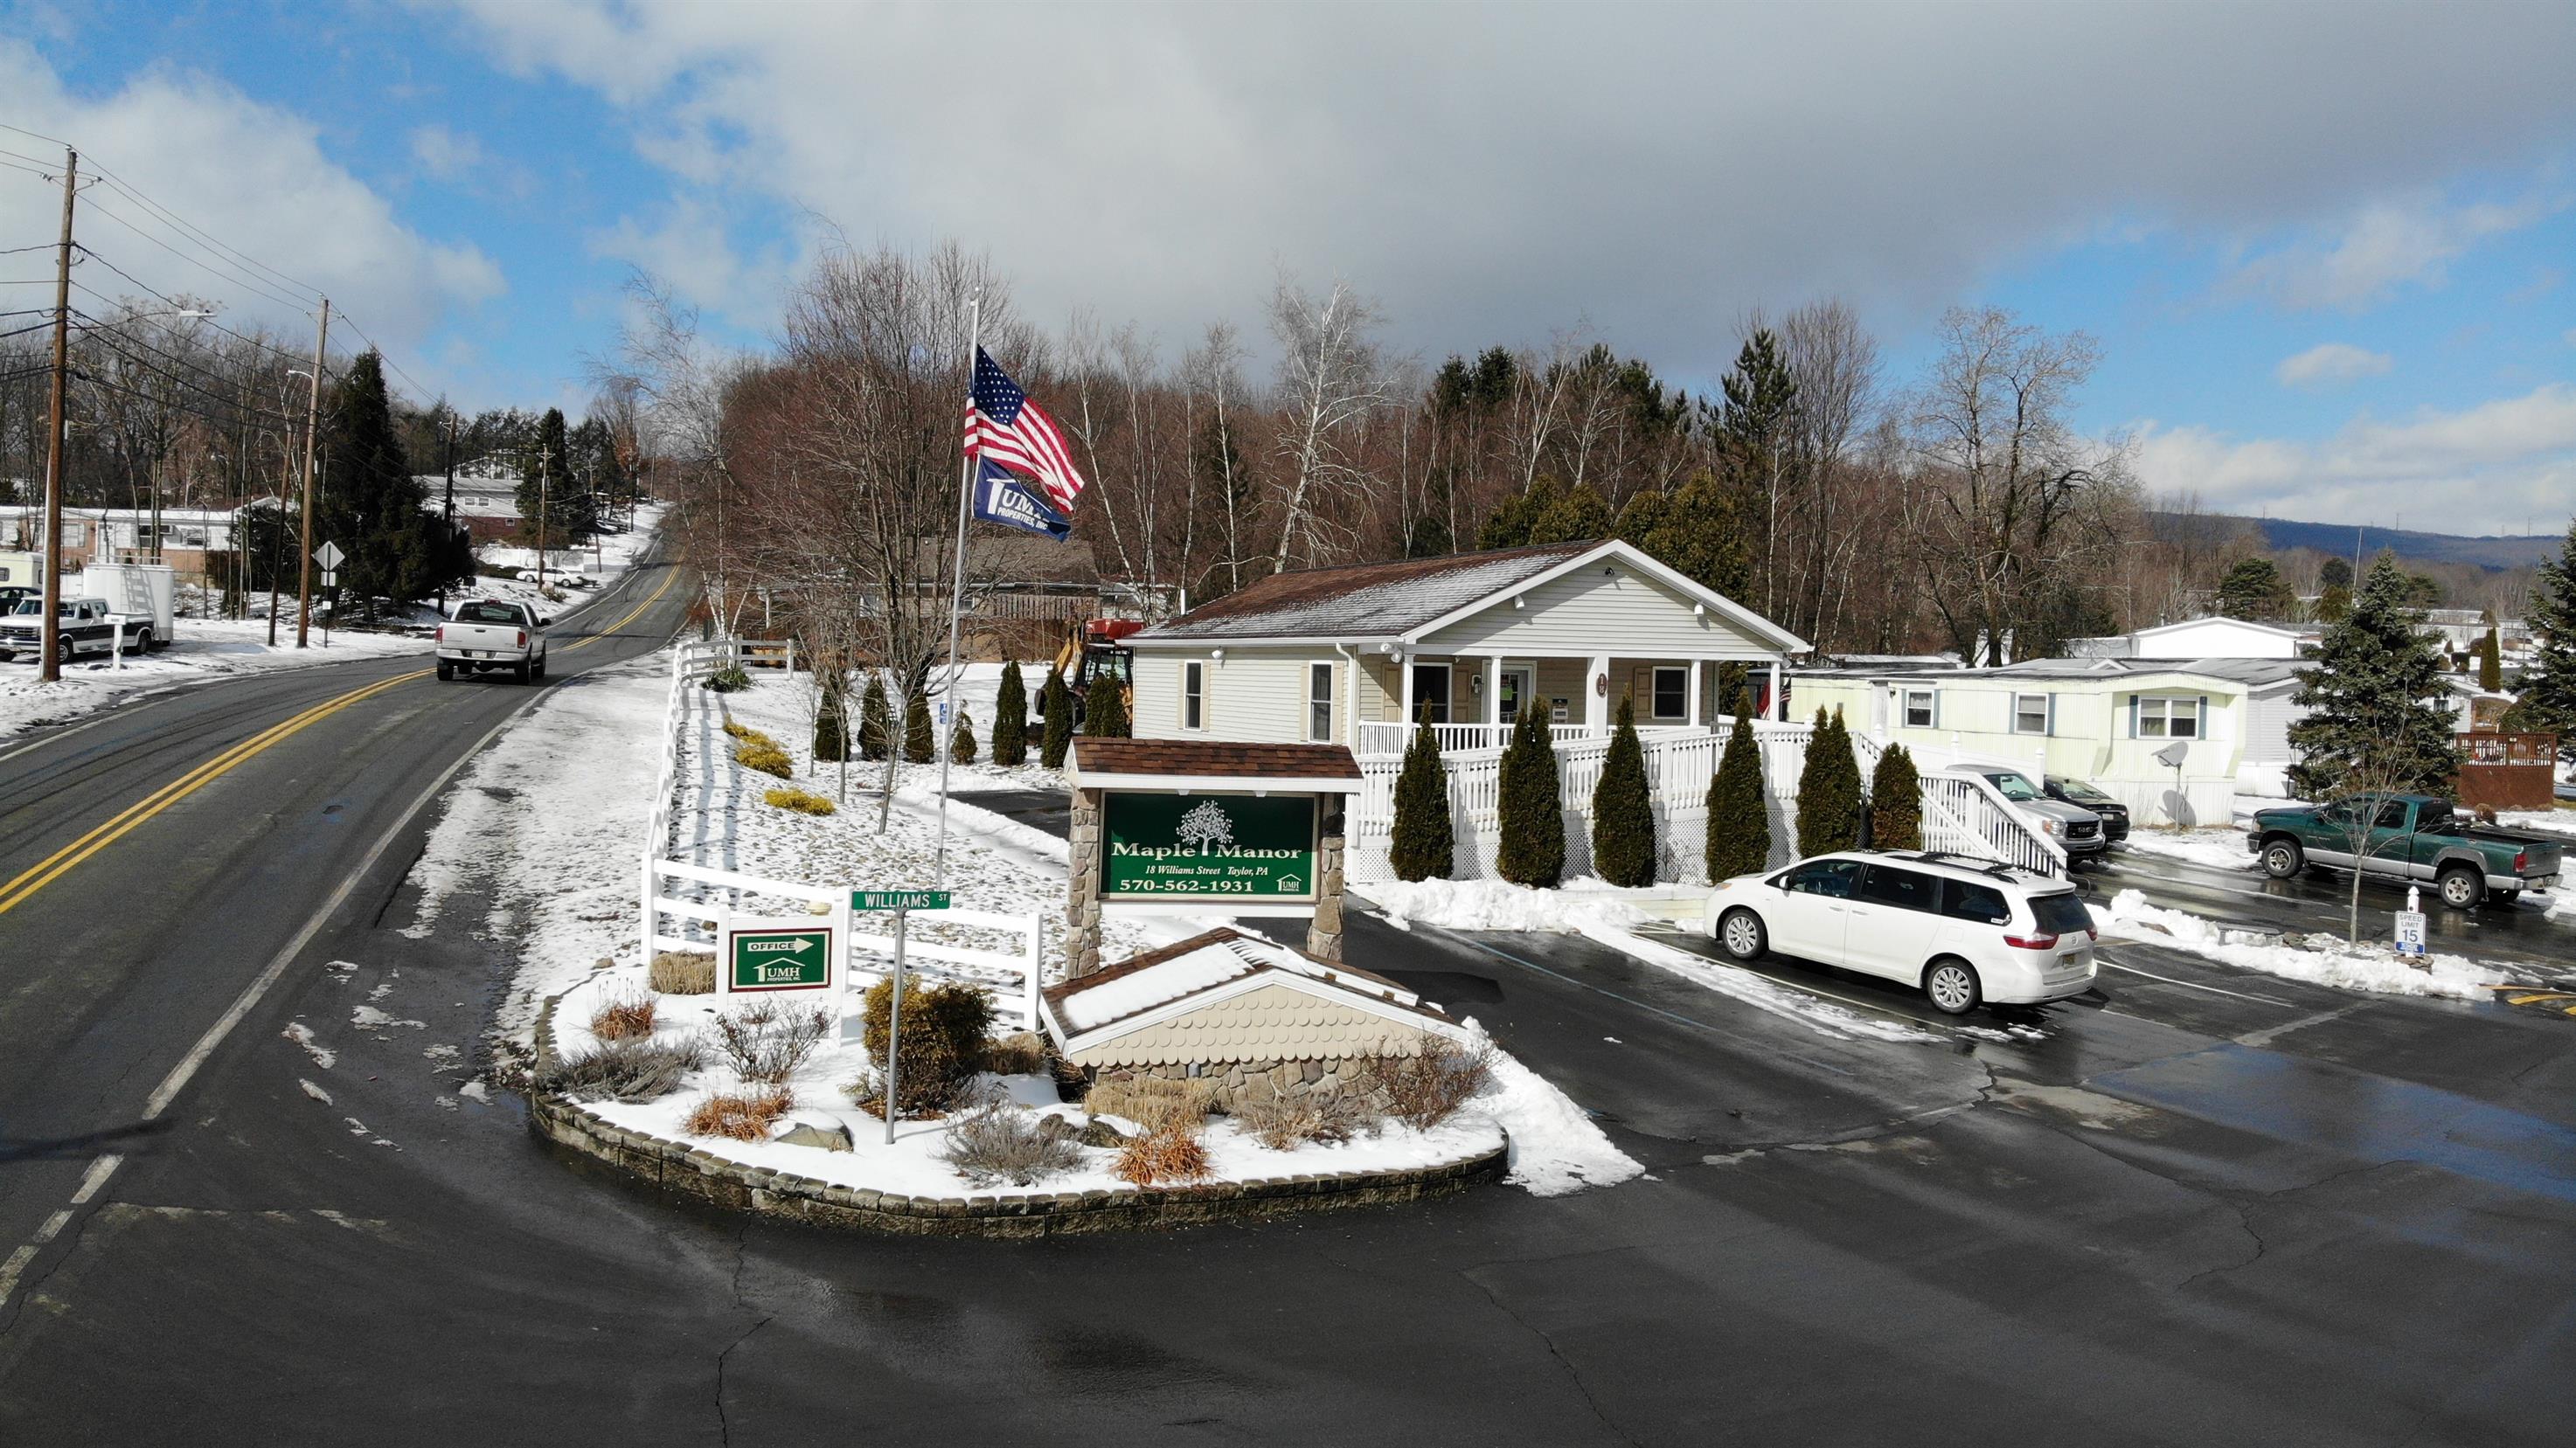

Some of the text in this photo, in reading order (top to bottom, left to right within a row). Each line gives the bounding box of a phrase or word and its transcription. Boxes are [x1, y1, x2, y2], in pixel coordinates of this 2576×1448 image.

[997, 507, 1034, 527] PROPERTIES,
[1111, 842, 1302, 861] Maple Manor
[1145, 865, 1268, 876] 18 Williams Street Taylor, PA
[1119, 879, 1253, 891] 570-562-1931
[864, 893, 930, 908] WILLIAMS
[2402, 929, 2419, 942] 15
[767, 967, 800, 977] UMH
